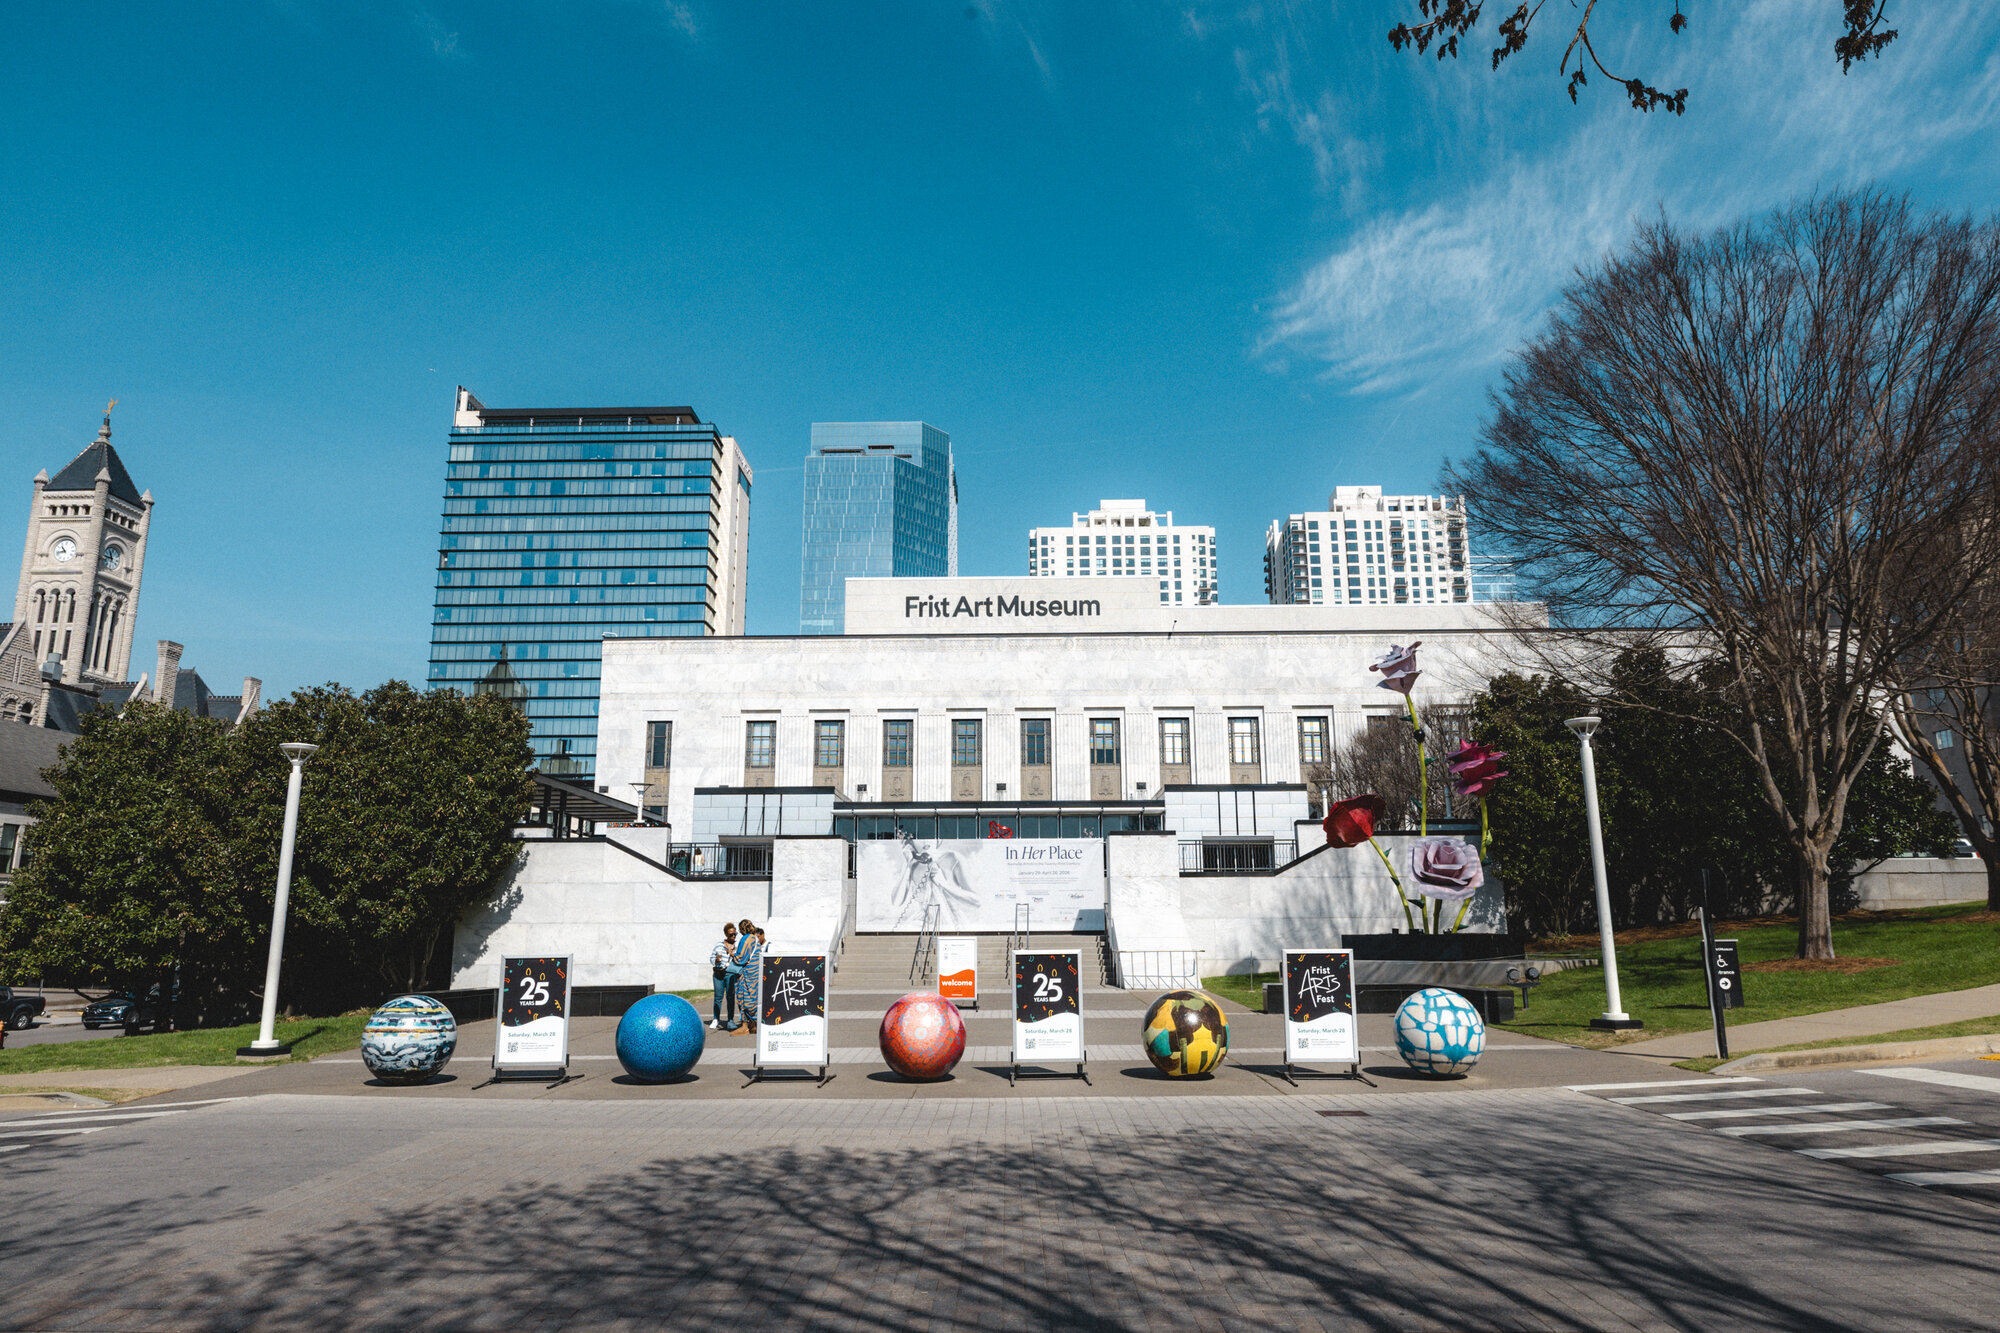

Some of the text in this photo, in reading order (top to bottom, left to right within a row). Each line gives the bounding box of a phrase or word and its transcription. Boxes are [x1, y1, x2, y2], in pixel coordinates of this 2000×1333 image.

[905, 595, 1101, 618] Frist Art Museum
[1006, 845, 1083, 860] In Her Place
[786, 969, 806, 977] Frist
[1311, 966, 1330, 974] Frist
[519, 977, 550, 1006] 25
[771, 971, 815, 1011] ARTS
[1032, 973, 1063, 1002] 25
[1298, 969, 1341, 1008] ARTS
[789, 998, 808, 1006] Fest
[1316, 995, 1335, 1003] Fest
